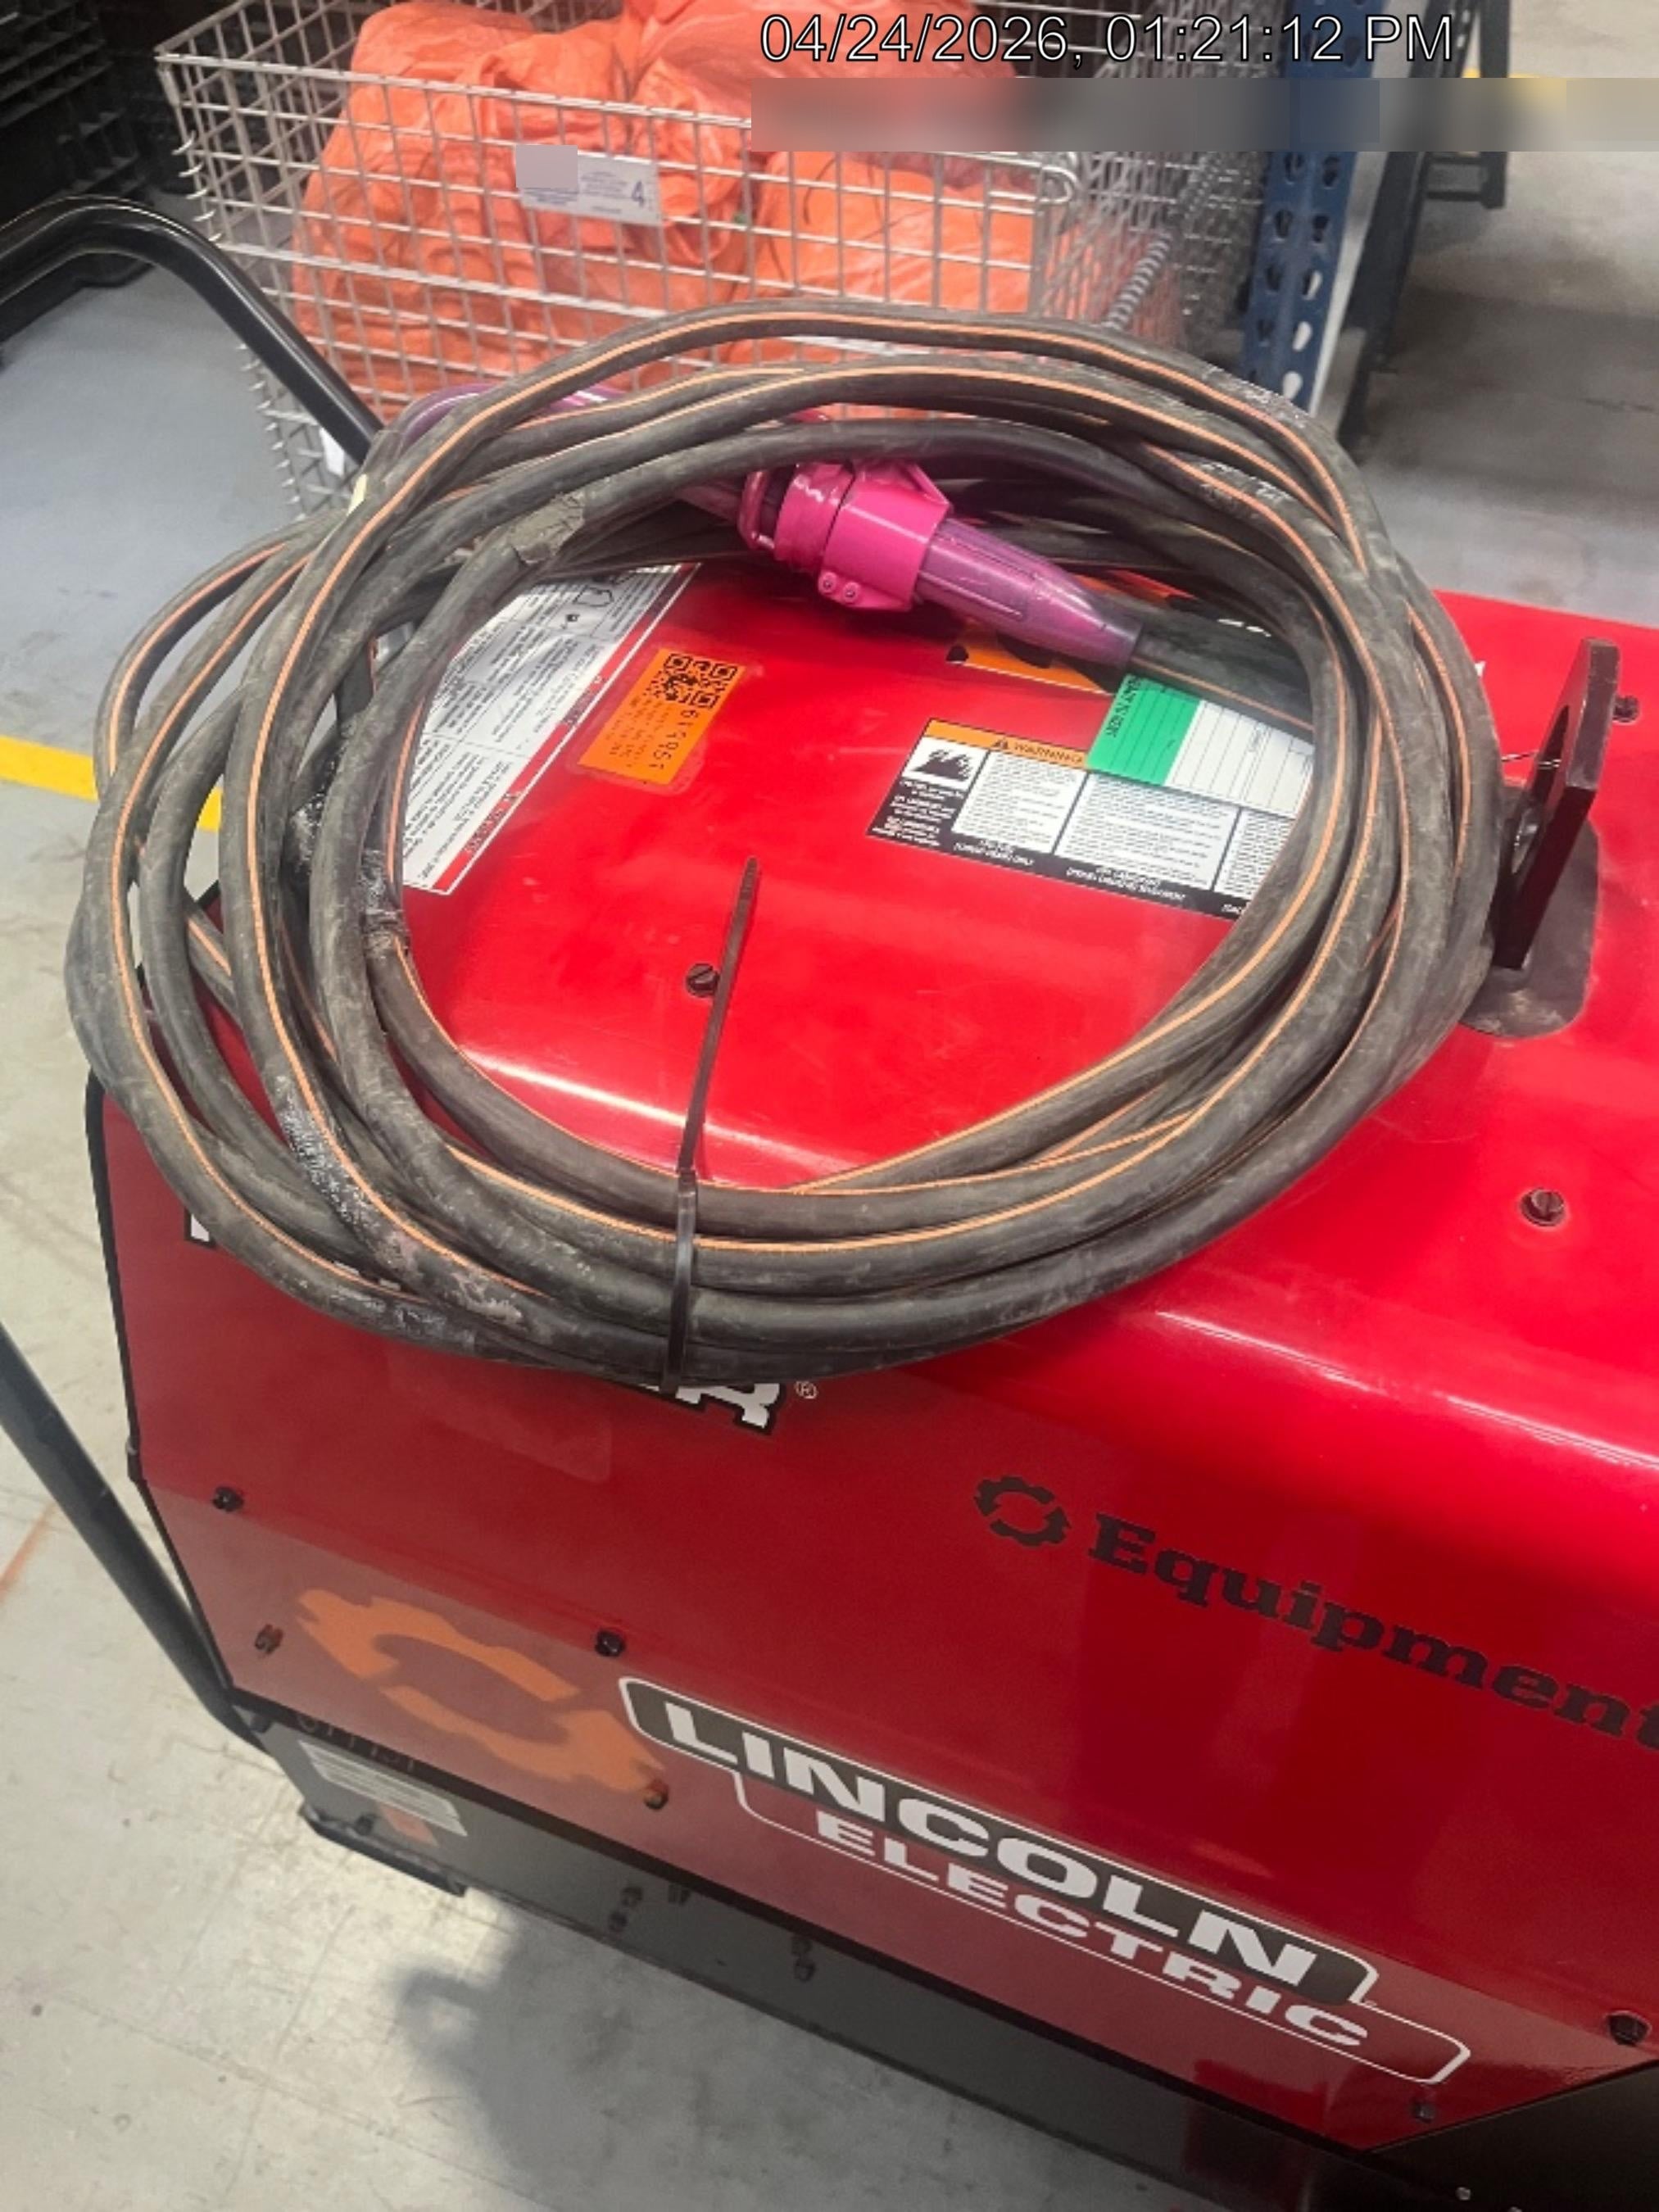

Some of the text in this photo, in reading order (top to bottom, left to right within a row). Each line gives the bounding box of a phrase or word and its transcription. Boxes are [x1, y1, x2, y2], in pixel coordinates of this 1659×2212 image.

[1012, 741, 1085, 765] WARNING
[1088, 1512, 1659, 1750] Equipment
[664, 1700, 1319, 1986] LINCOLN
[816, 1809, 1370, 2047] ELECTRIC
